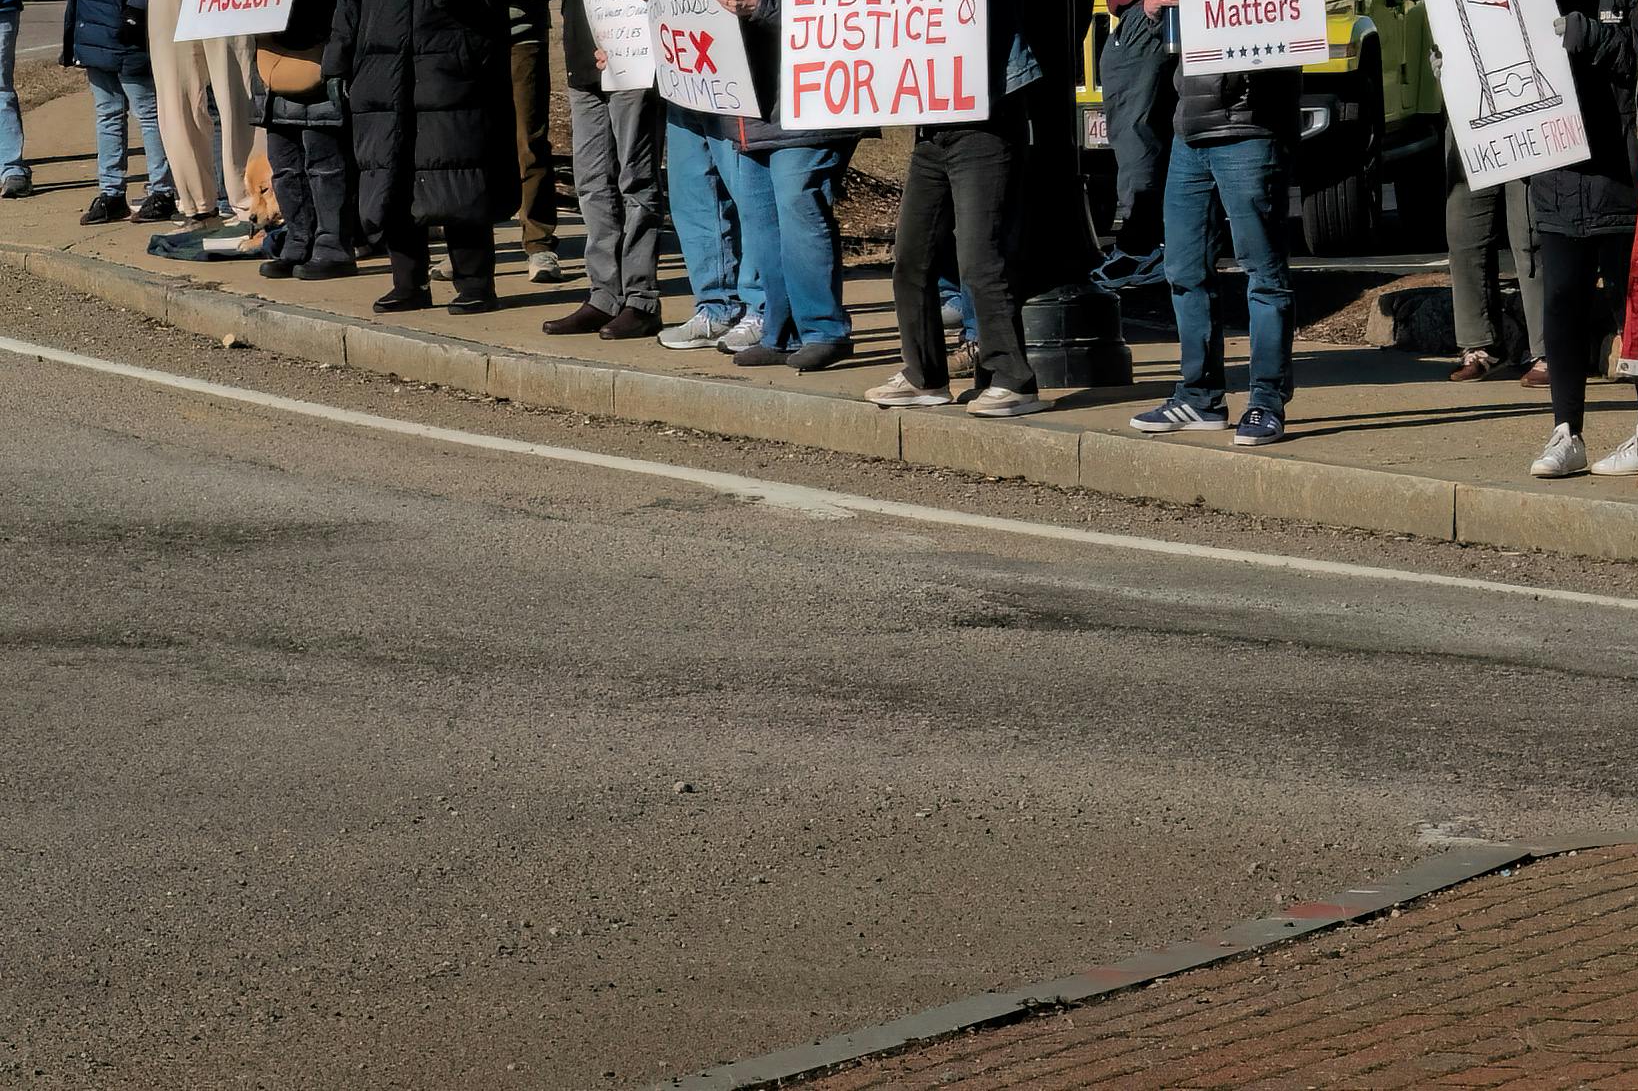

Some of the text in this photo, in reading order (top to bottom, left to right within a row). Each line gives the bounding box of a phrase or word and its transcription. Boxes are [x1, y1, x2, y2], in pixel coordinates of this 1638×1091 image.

[659, 23, 718, 75] SEX
[790, 6, 946, 51] JUSTICE
[659, 63, 741, 110] CRIMES
[793, 55, 976, 118] FOR ALL
[1464, 113, 1584, 174] LIKE THE FRENCH
